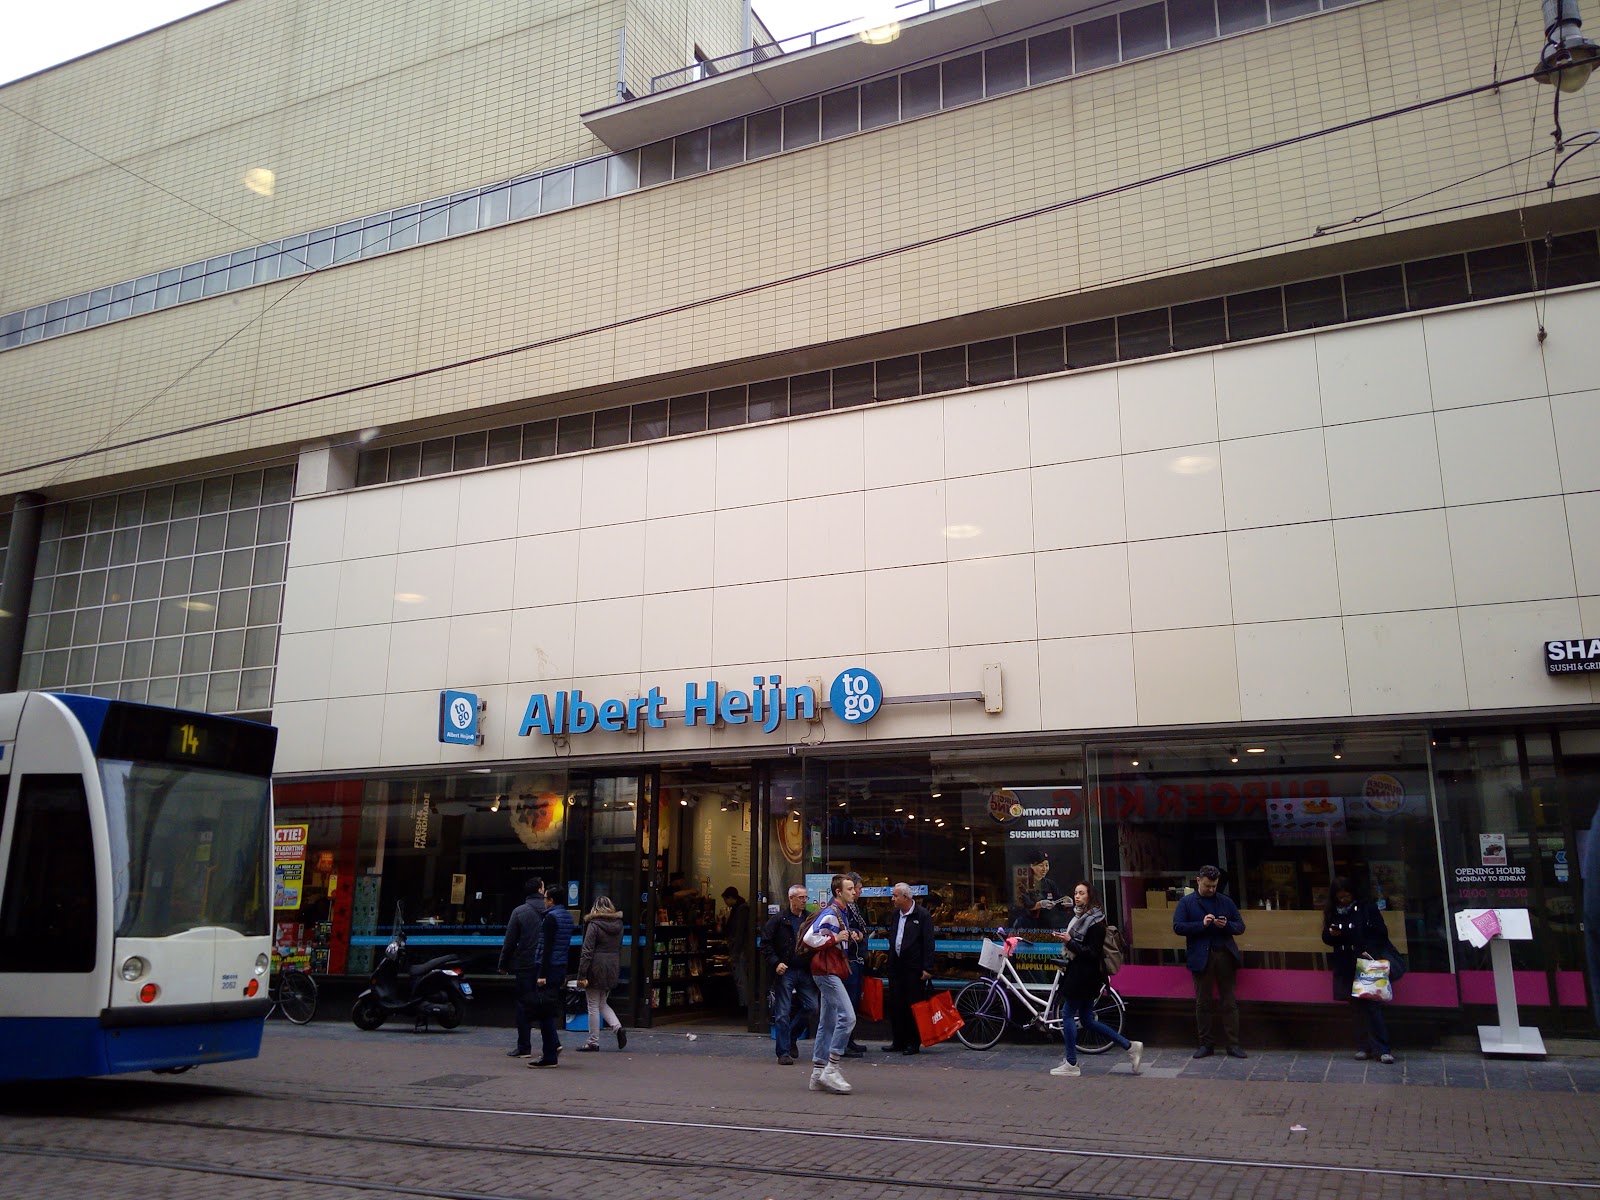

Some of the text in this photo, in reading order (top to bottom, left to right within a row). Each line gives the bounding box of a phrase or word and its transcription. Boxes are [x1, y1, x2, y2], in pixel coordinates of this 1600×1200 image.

[842, 673, 868, 696] to
[454, 702, 466, 714] to
[518, 675, 815, 737] Albert Heijn
[844, 694, 873, 722] go
[458, 711, 470, 727] go
[180, 724, 199, 755] 14
[1058, 807, 1072, 816] UW
[419, 791, 431, 849] HANDMADE
[1028, 818, 1060, 828] NIEUWE
[275, 828, 302, 842] CTIE!
[1009, 830, 1080, 839] SUSHIMEESTERS!
[1455, 866, 1526, 876] OPENING HOURS
